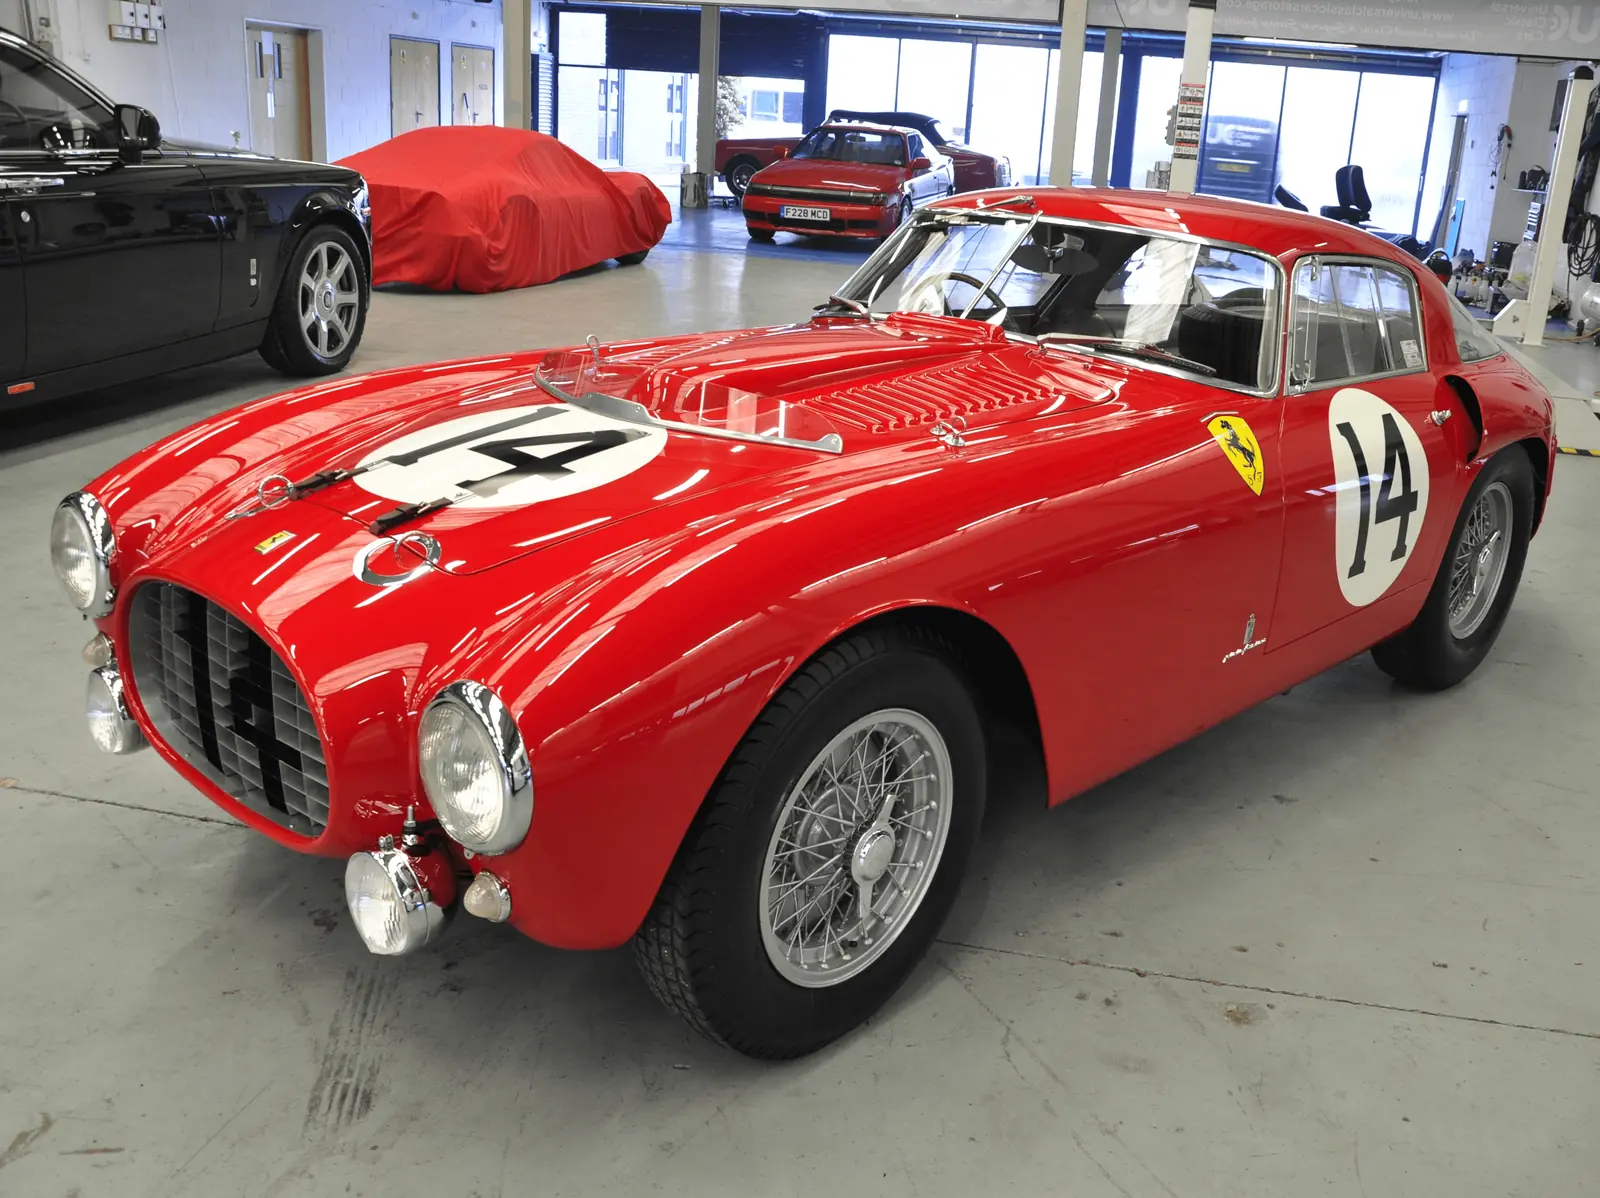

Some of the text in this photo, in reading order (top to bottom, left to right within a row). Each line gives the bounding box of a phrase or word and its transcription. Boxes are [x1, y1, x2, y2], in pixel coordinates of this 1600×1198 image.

[785, 207, 828, 219] F228 MCD
[382, 407, 652, 498] 14
[1336, 413, 1418, 579] 14
